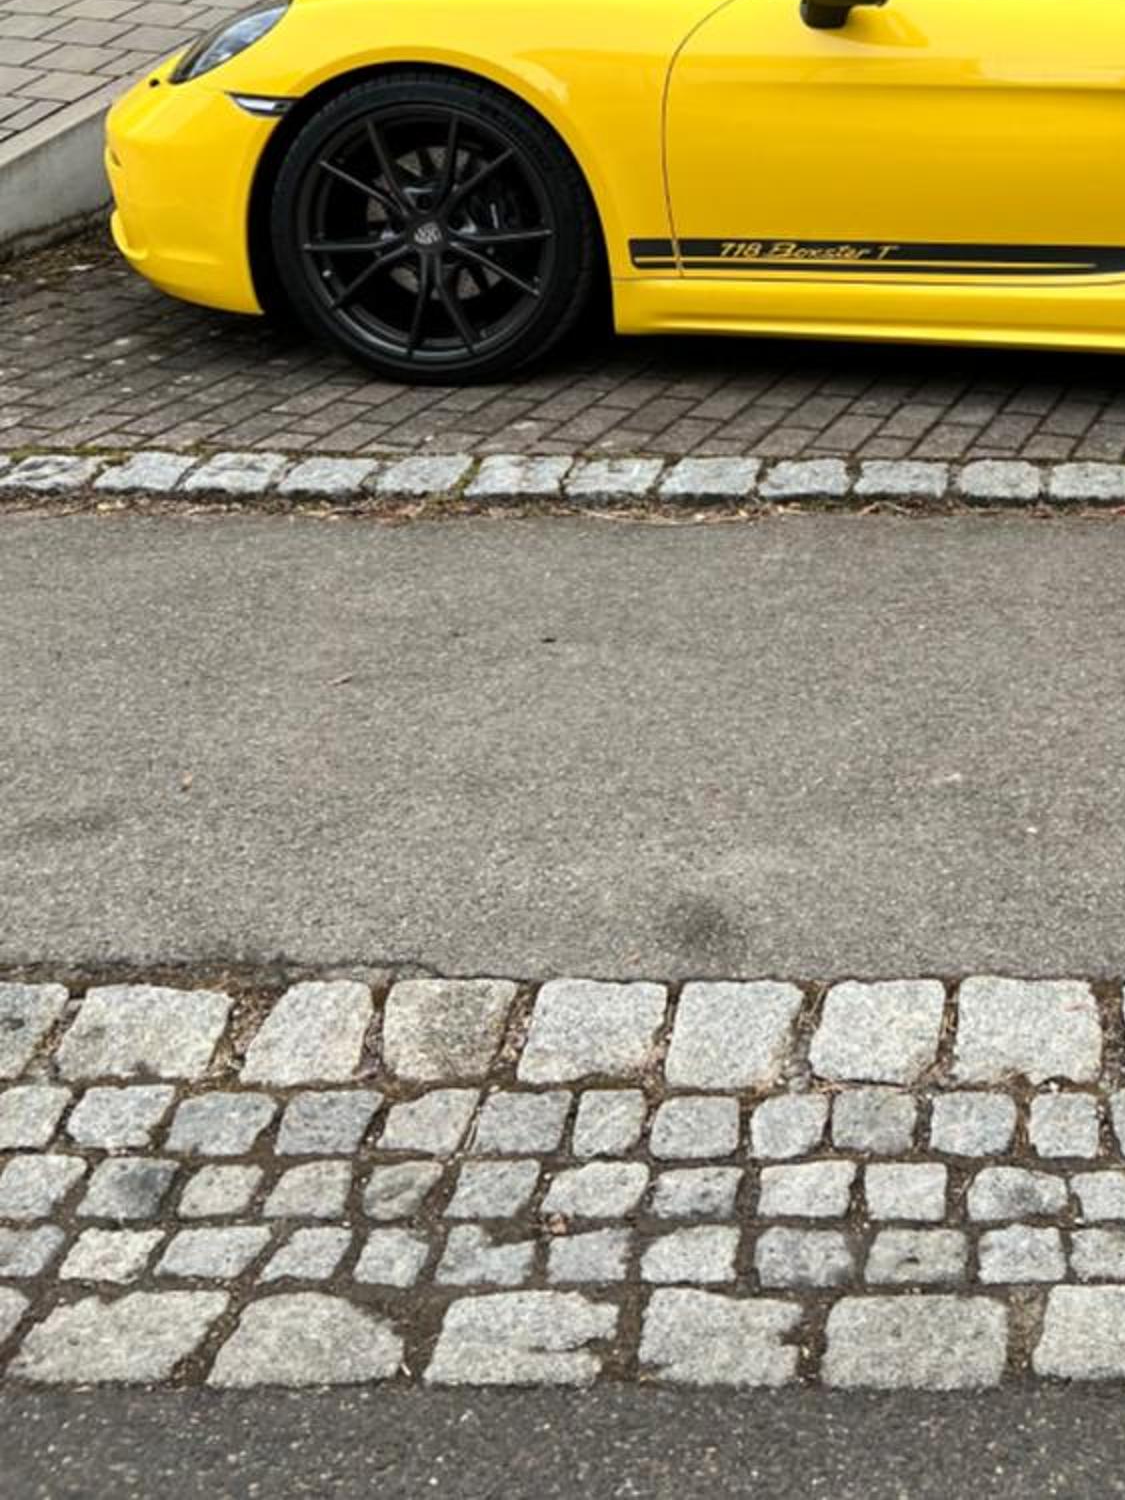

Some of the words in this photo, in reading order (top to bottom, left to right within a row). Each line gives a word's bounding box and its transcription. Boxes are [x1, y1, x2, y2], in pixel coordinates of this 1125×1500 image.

[720, 241, 762, 258] 718
[769, 241, 871, 259] Boxster
[877, 245, 900, 260] T
